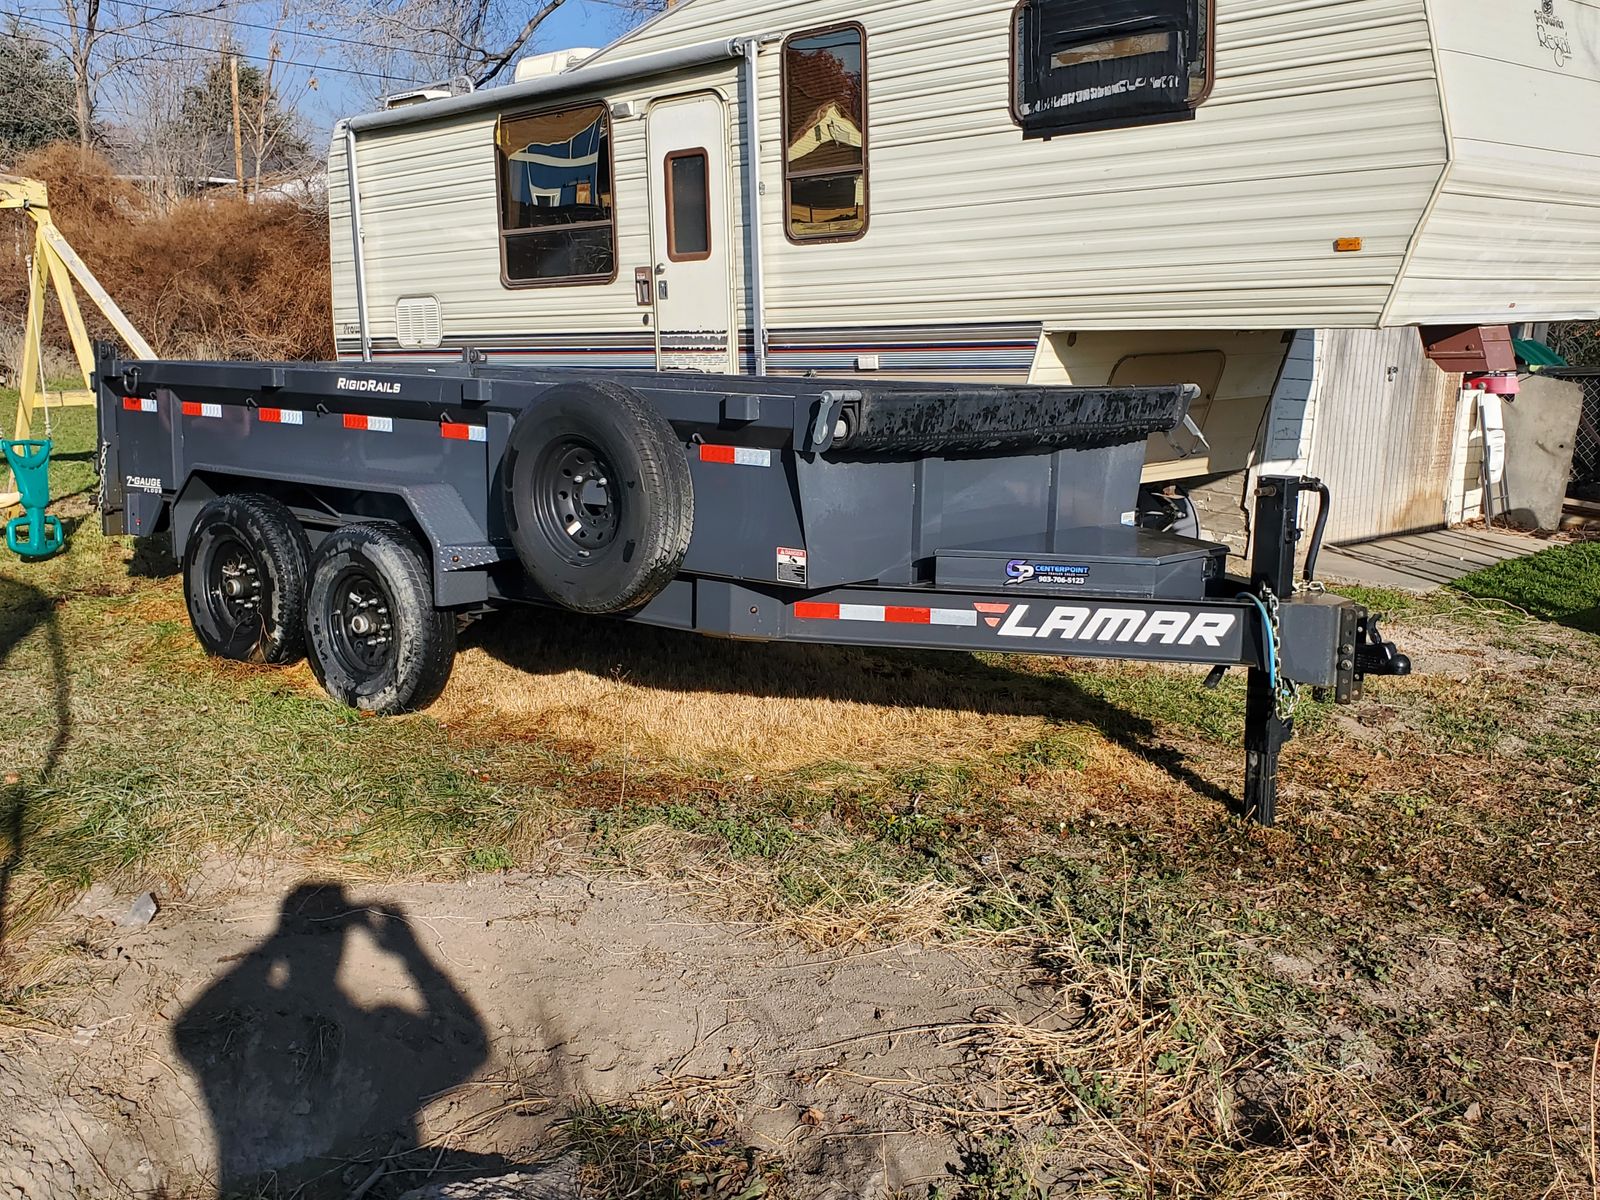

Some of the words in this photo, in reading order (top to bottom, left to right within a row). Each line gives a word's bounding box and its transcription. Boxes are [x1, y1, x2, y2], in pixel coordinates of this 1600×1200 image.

[1035, 565, 1089, 574] CENTERPOINT
[1038, 576, 1085, 585] 903-706-5123
[996, 604, 1236, 647] LAMAR
